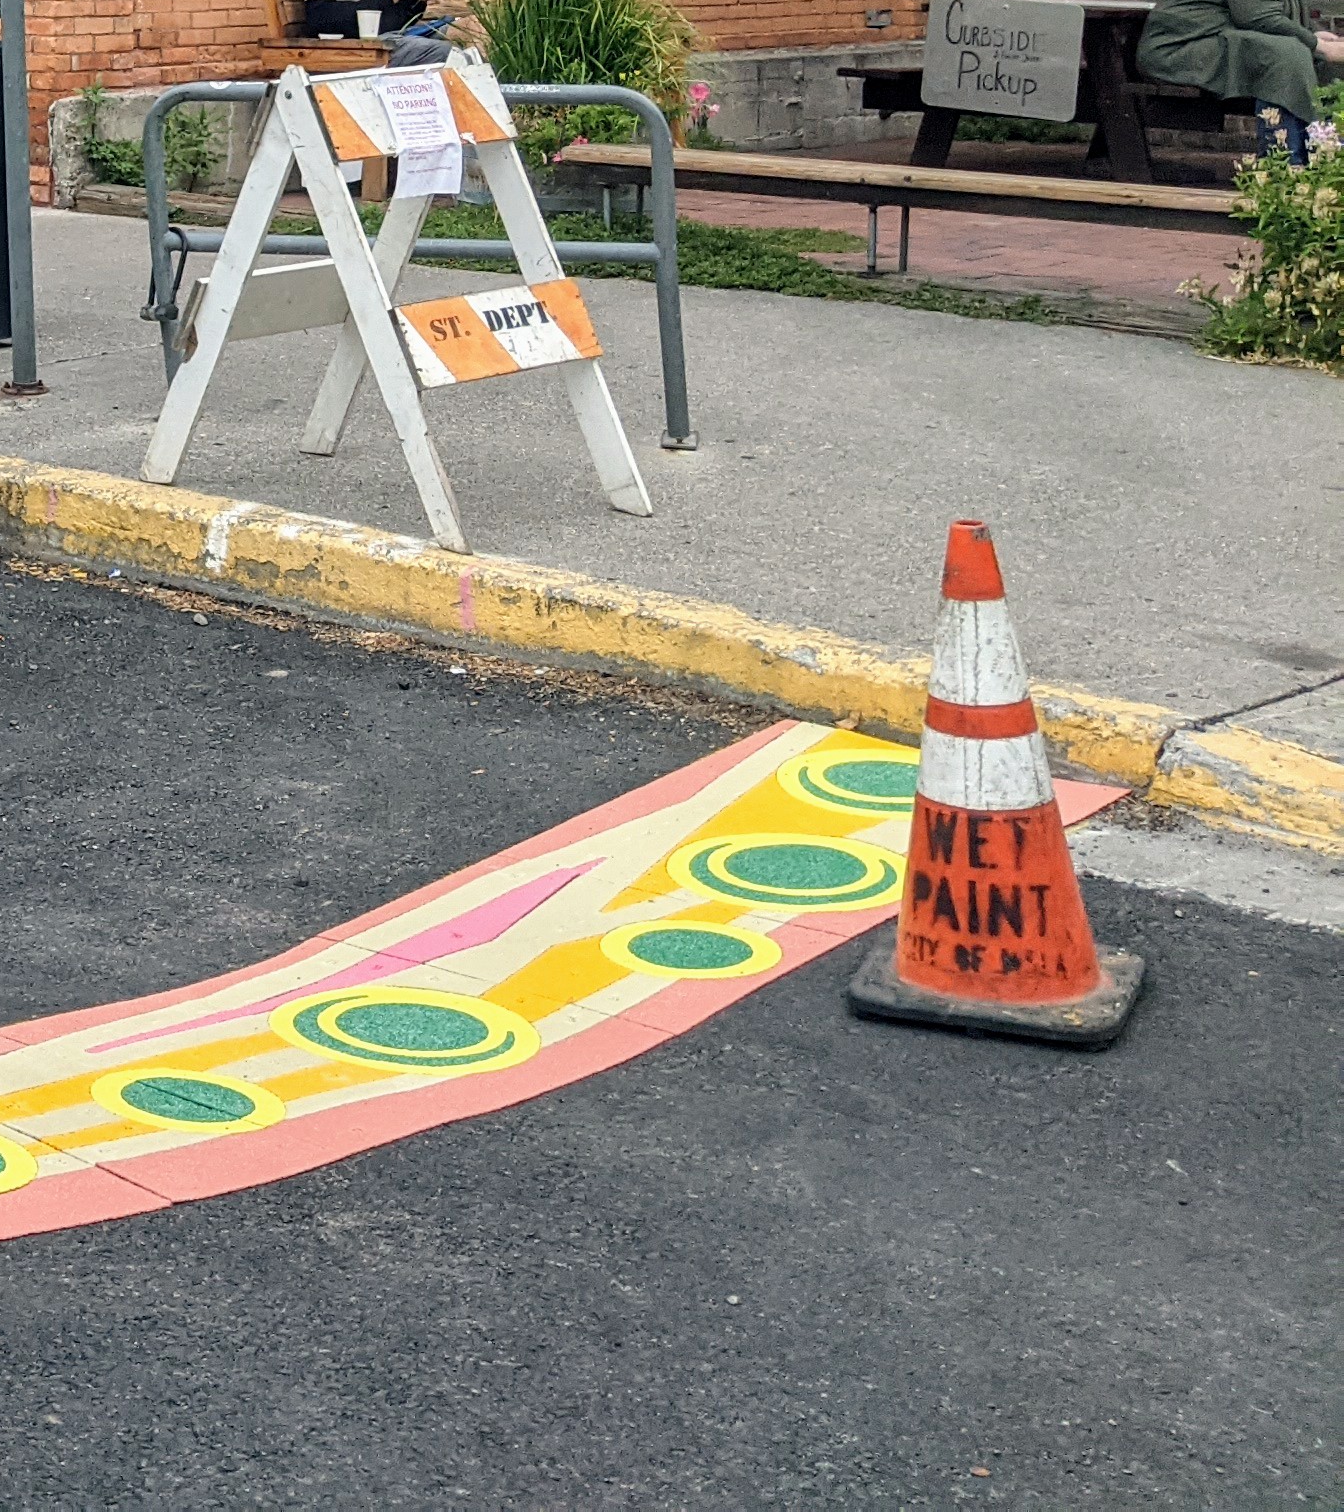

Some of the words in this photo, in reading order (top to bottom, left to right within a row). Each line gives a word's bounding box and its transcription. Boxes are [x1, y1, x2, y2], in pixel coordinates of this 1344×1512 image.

[405, 97, 438, 109] PARKING
[429, 315, 472, 342] ST.
[925, 807, 1031, 870] WET
[914, 870, 1051, 938] PAINT
